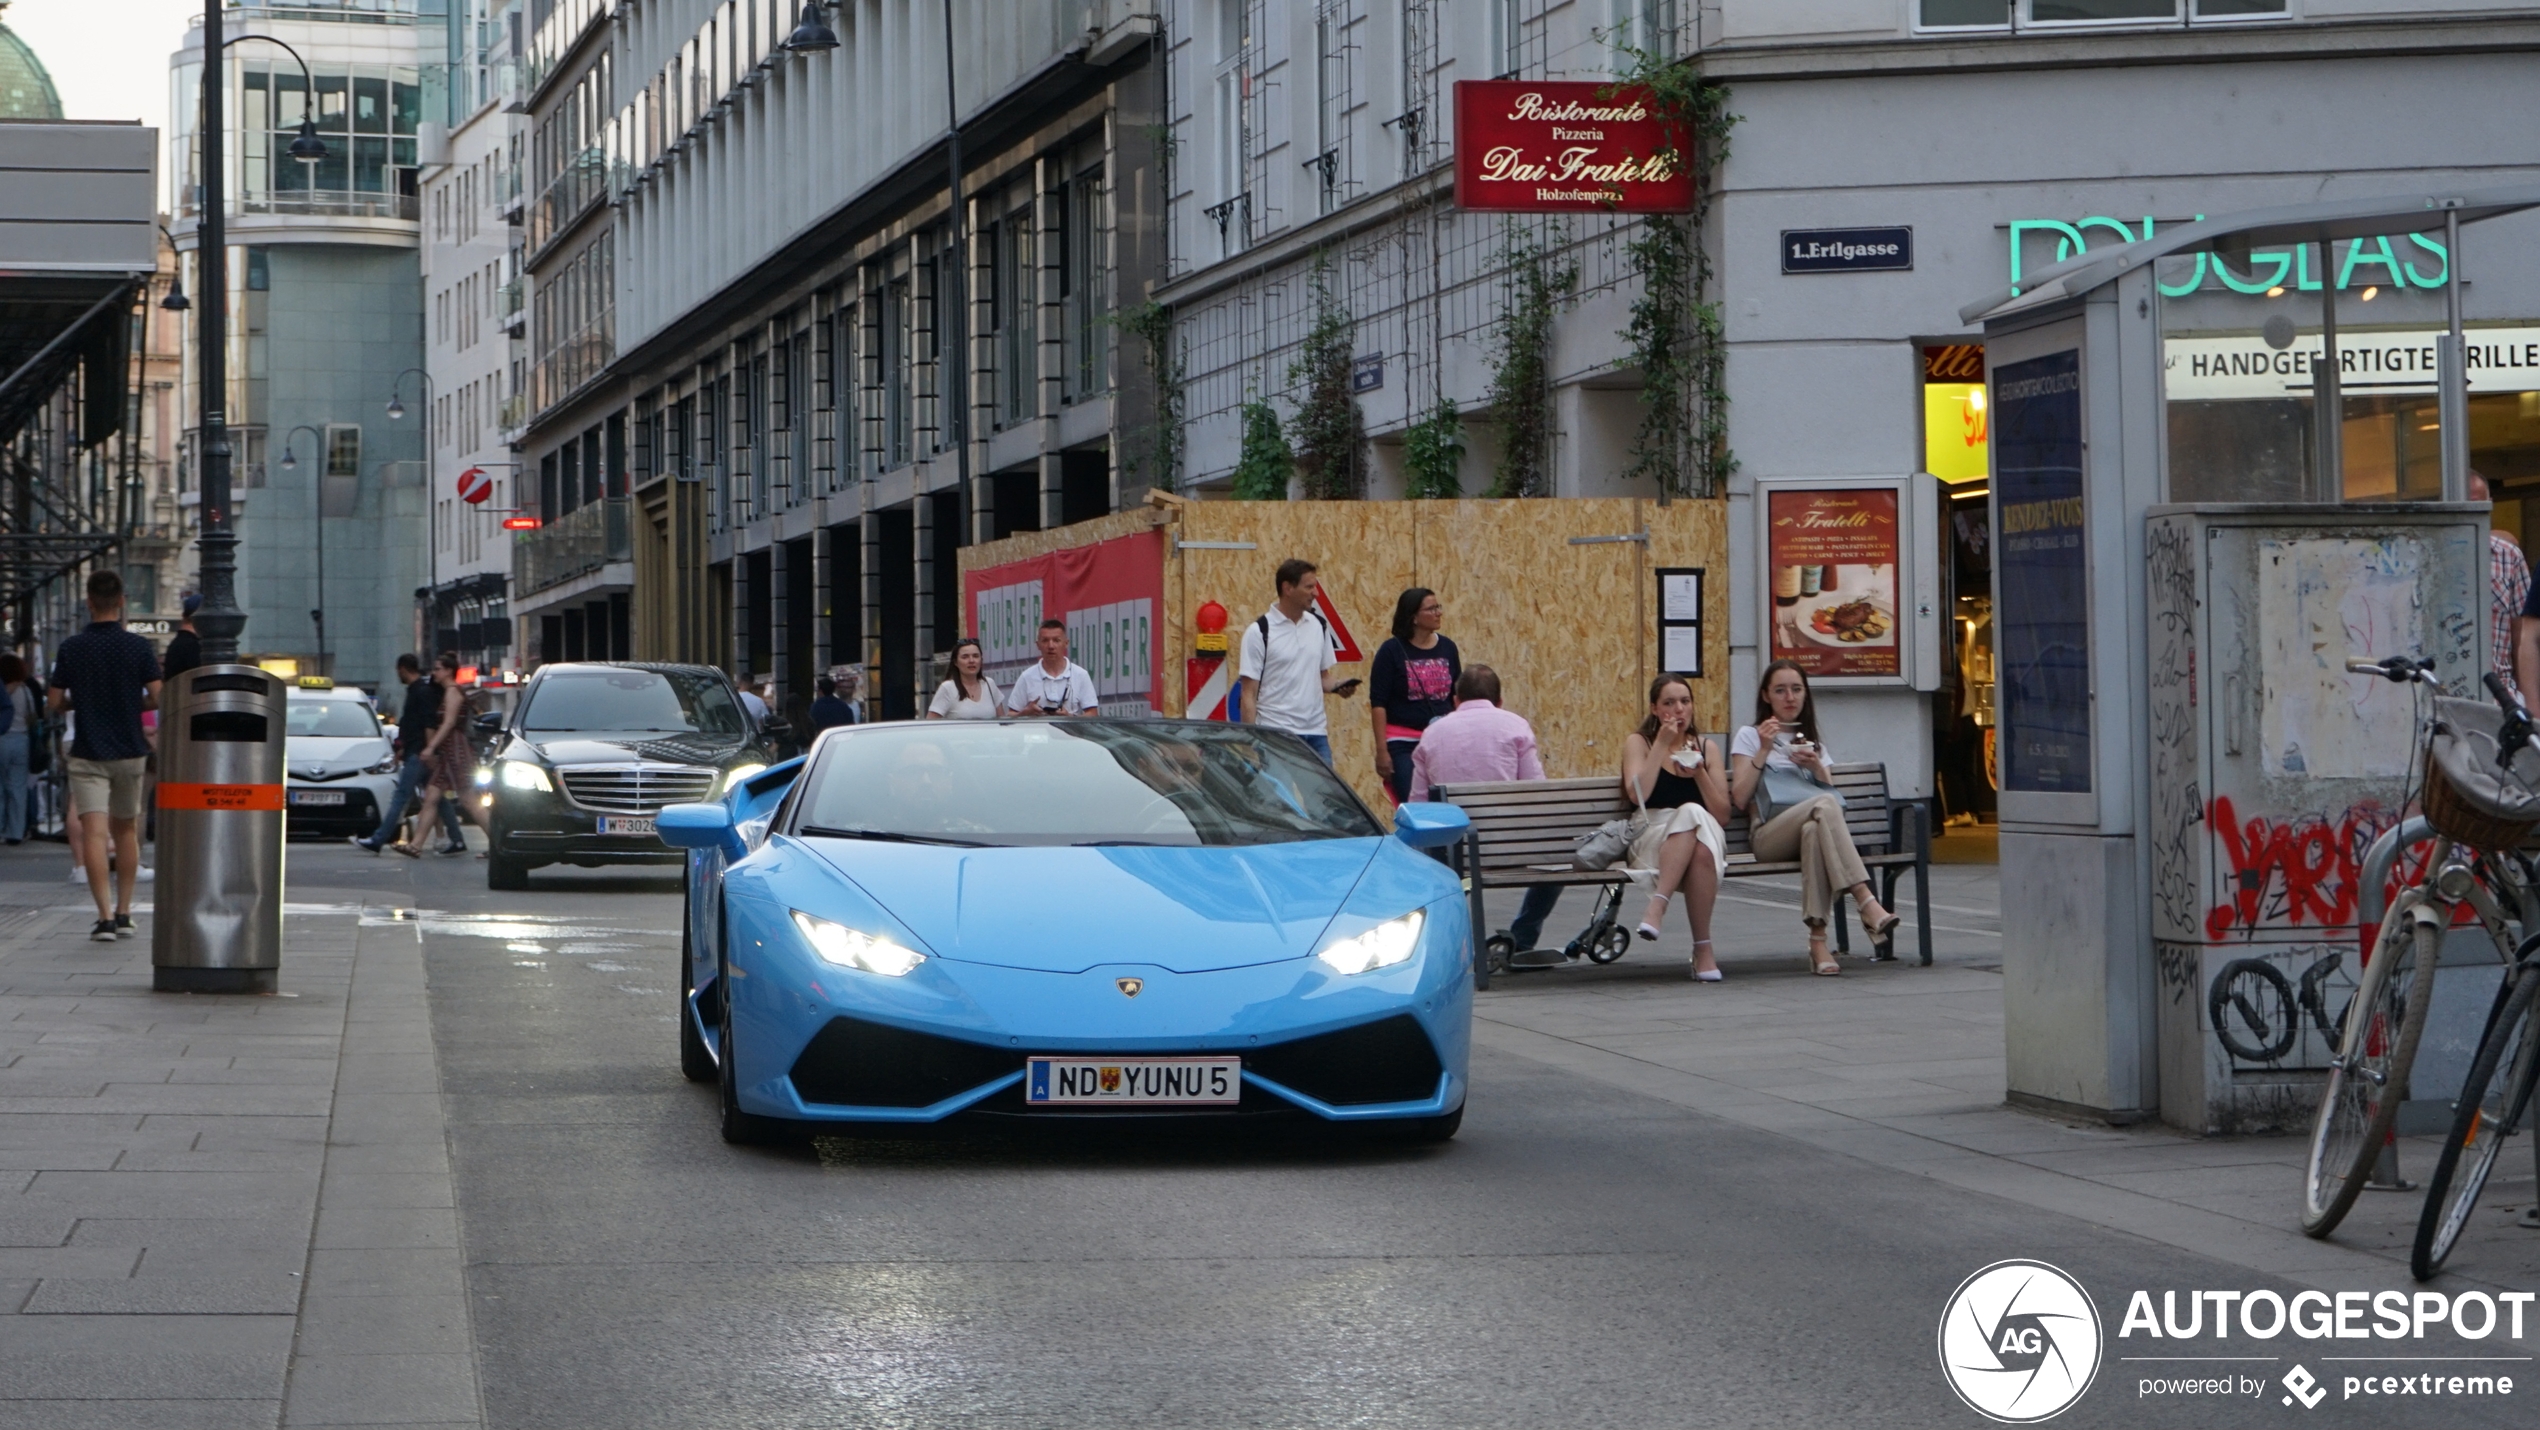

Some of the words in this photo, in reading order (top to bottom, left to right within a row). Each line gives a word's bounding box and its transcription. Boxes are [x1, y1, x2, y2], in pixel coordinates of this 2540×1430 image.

[1507, 92, 1647, 122] Ristorante
[1552, 127, 1604, 140] Pizzeria
[1479, 146, 1551, 182] Dai
[1550, 146, 1679, 182] Fratelli
[2192, 347, 2435, 377] HANDGEFRTIGTE
[2467, 344, 2539, 369] RILLE
[1796, 510, 1871, 528] Fratelli
[979, 594, 1042, 650] HUBER
[1069, 616, 1149, 681] HUBER
[608, 820, 617, 831] W
[1036, 1086, 1045, 1095] A
[1059, 1067, 1097, 1097] ND
[1124, 1067, 1202, 1097] YUNU
[1211, 1067, 1228, 1097] 5
